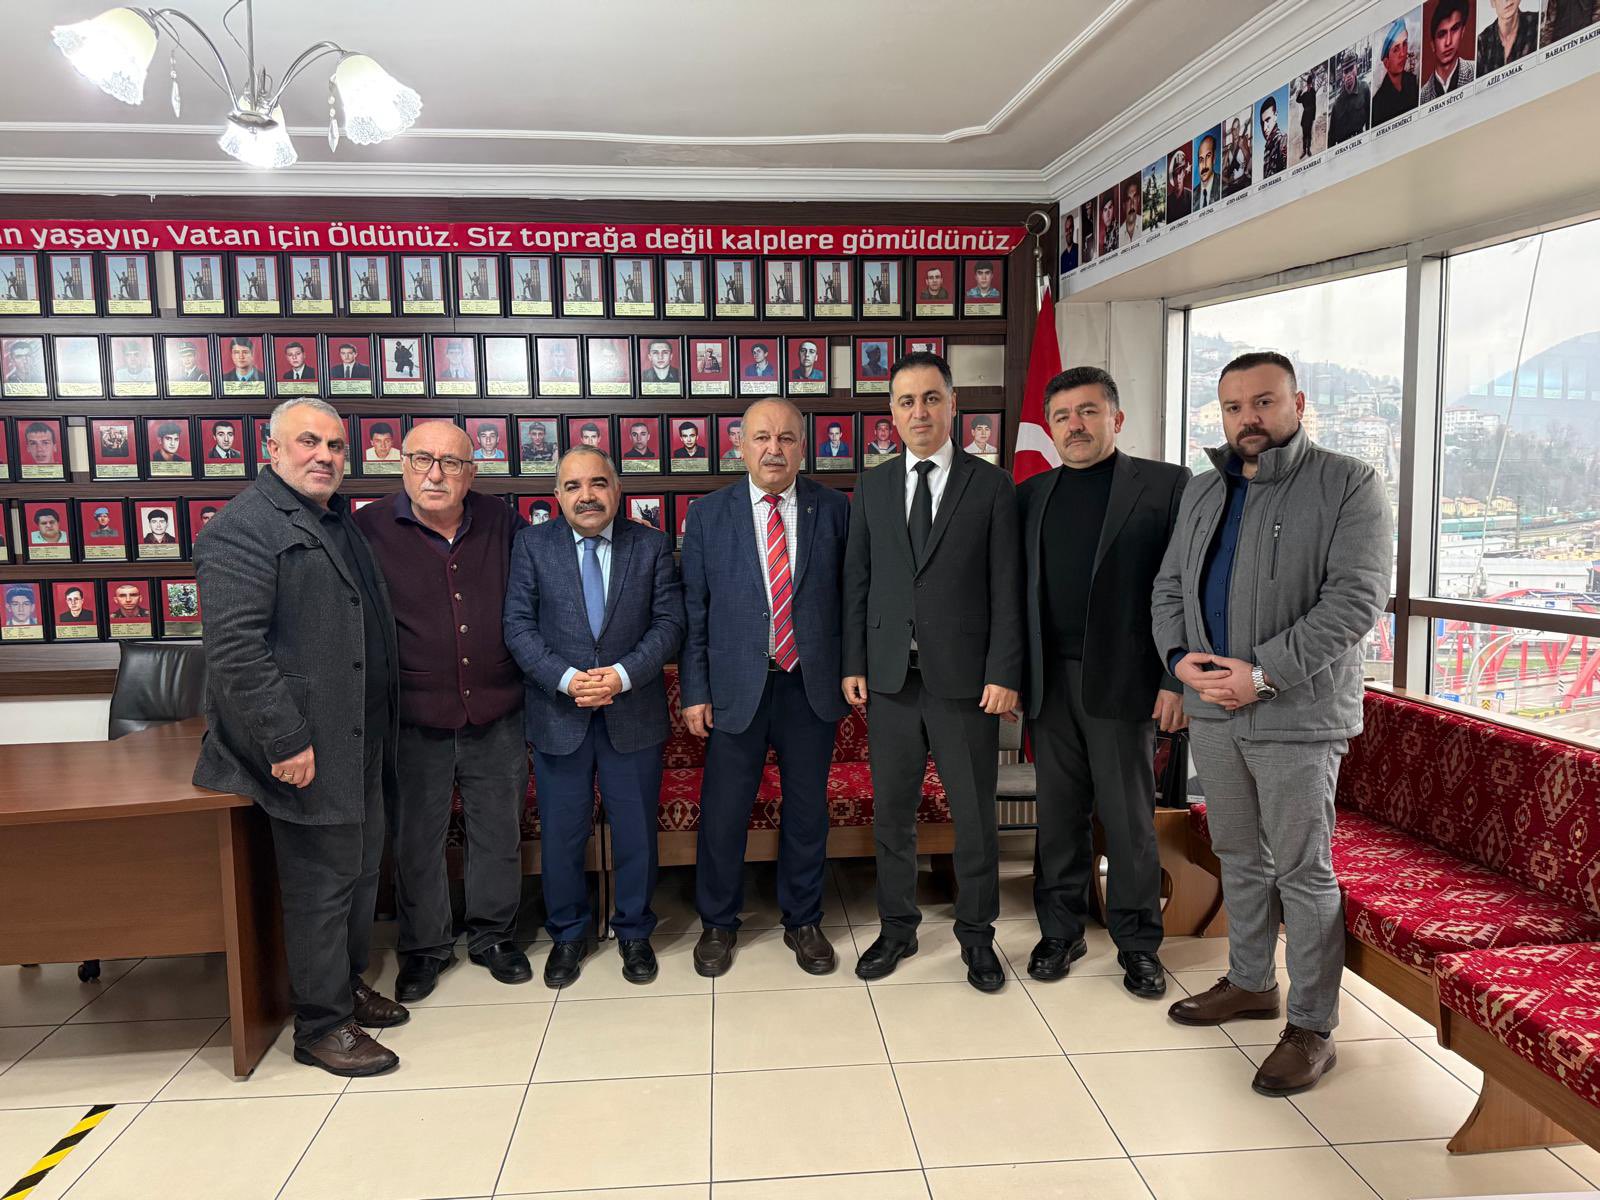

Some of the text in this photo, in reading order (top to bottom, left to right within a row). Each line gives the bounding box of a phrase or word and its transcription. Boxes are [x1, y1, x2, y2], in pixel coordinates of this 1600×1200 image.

[30, 226, 159, 249] yaşayıp,
[166, 225, 260, 246] Vatan
[268, 225, 319, 249] için
[328, 222, 458, 247] Öldünüz.
[467, 226, 513, 247] Siz
[520, 227, 637, 253] toprağa
[645, 227, 713, 254] değil
[722, 229, 834, 255] kalplere
[842, 229, 1016, 254] gömüldünüz.
